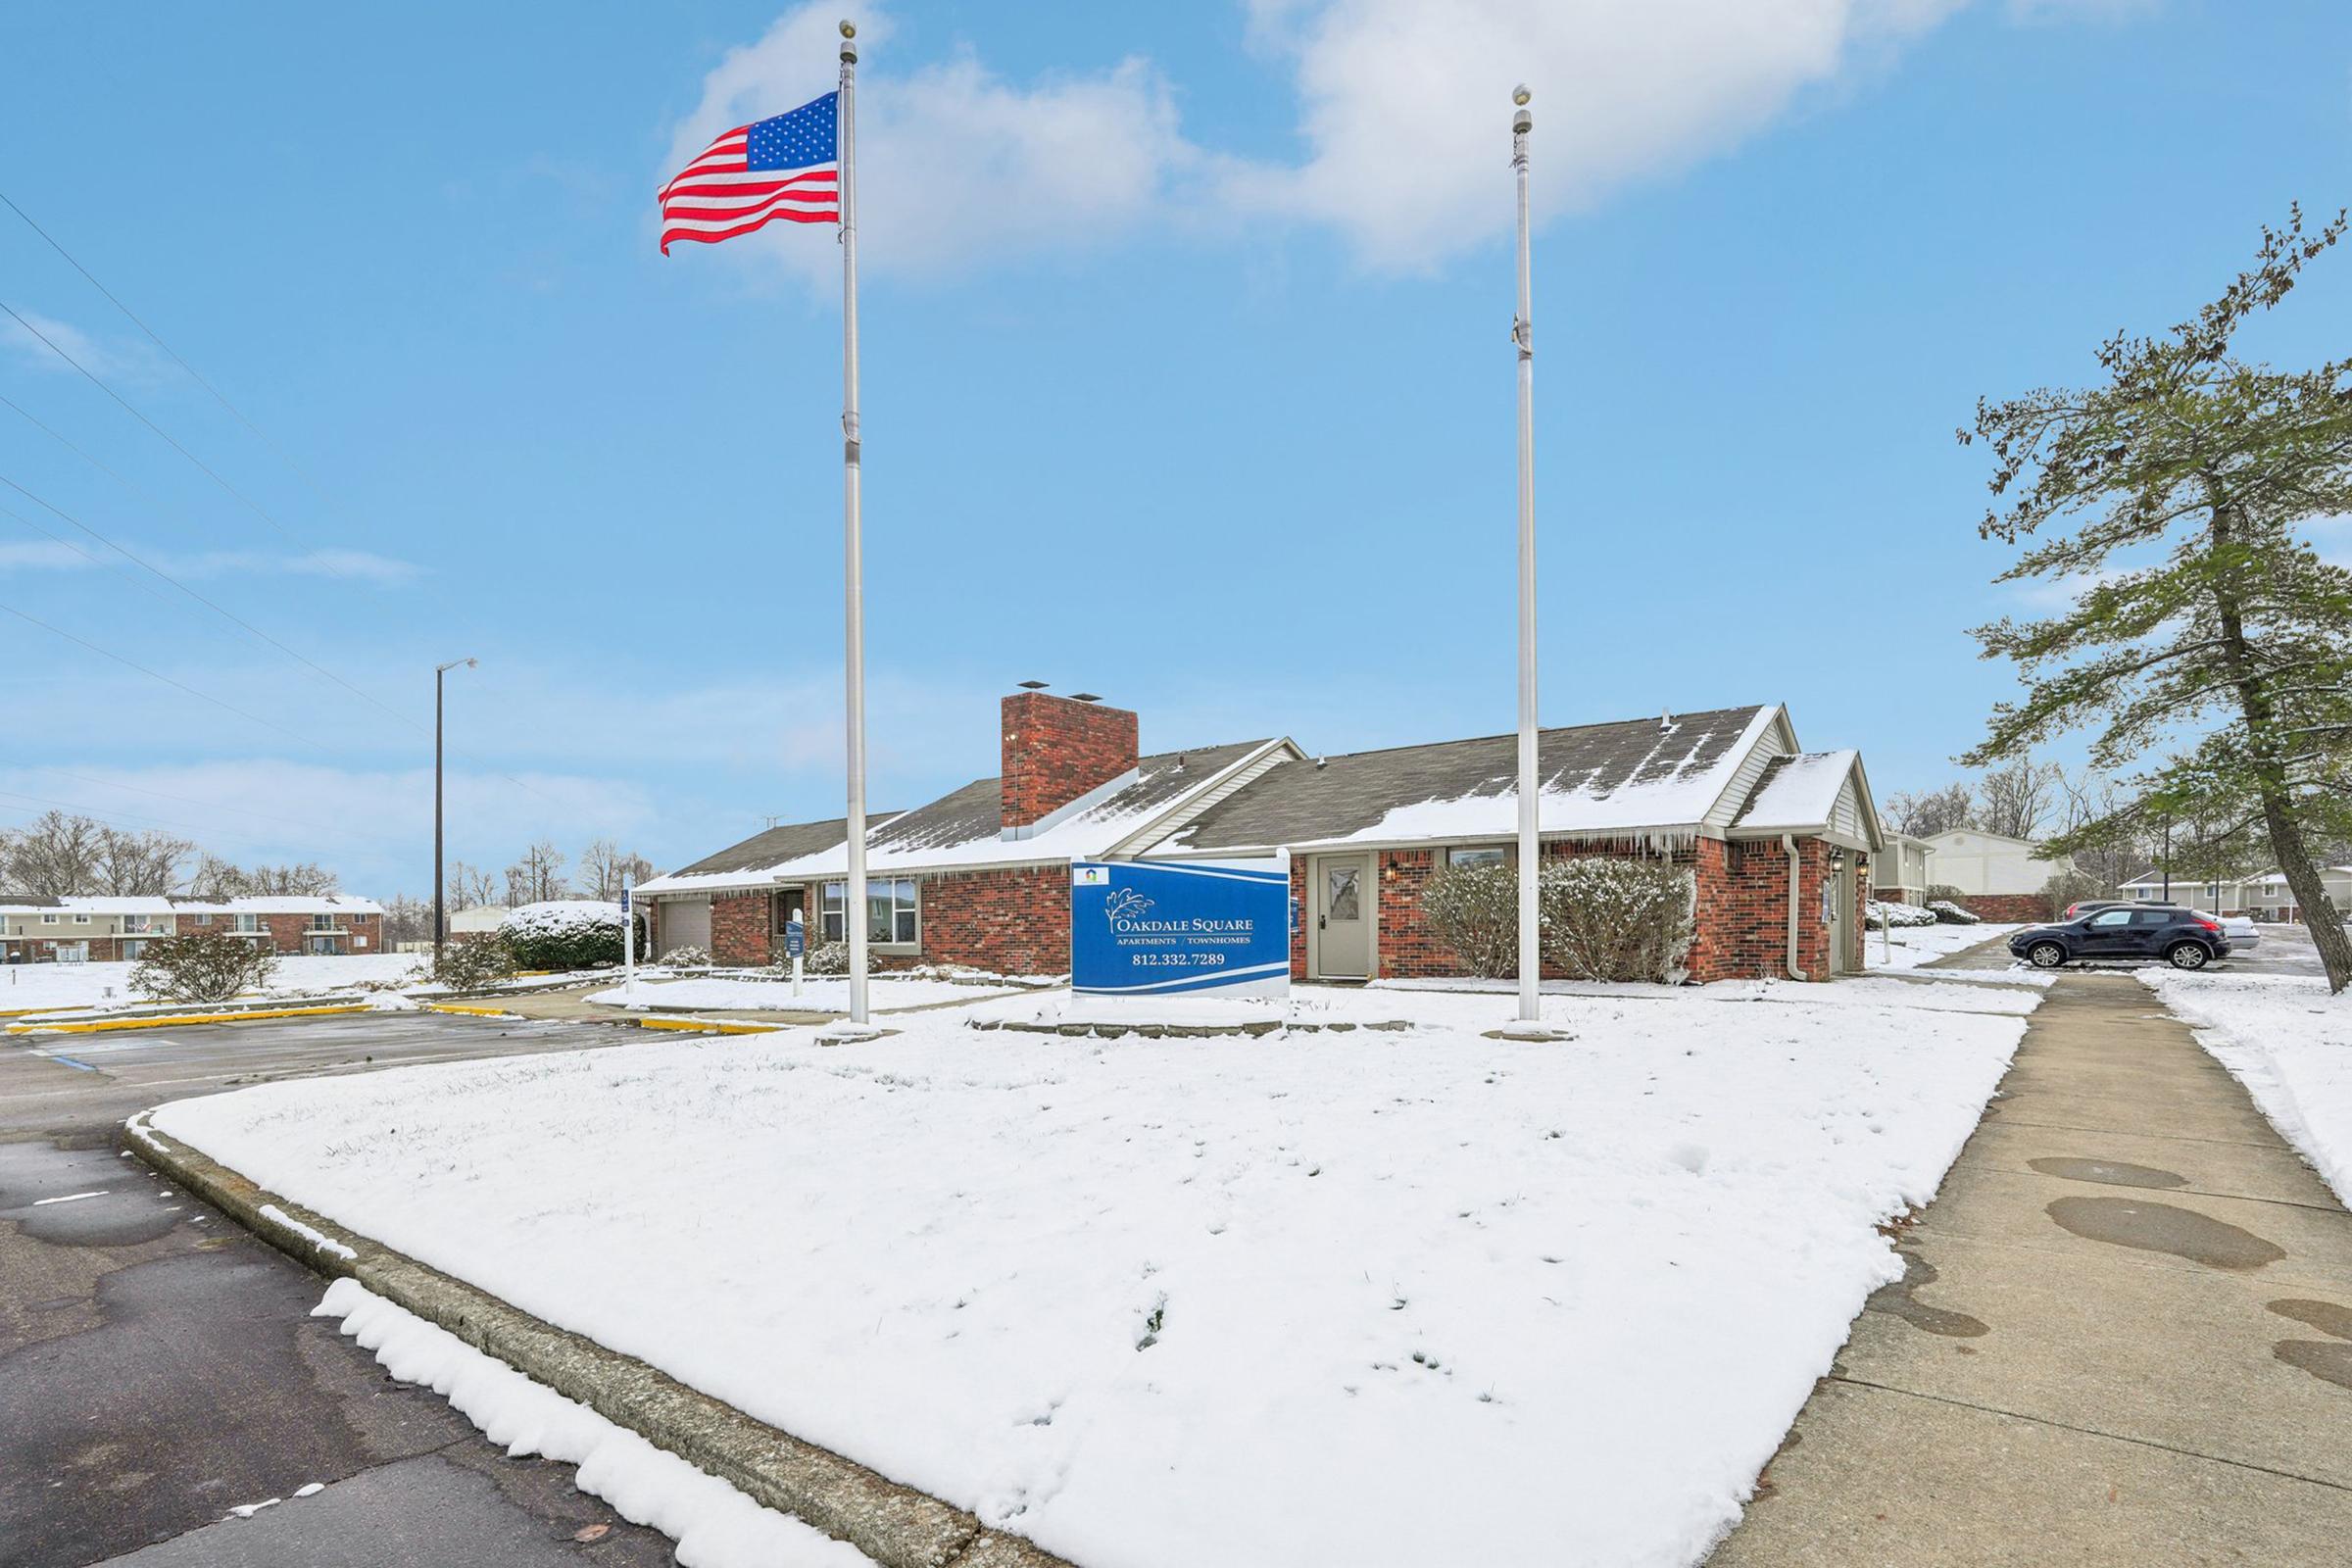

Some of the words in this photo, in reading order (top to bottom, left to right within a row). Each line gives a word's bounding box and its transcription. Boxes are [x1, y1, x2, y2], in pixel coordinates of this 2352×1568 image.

[1116, 919, 1190, 932] OAKDALE
[1192, 917, 1253, 932] SQUARE
[1116, 937, 1177, 946] APARTMENTS
[1187, 936, 1251, 945] TOWNHOMES
[1132, 954, 1225, 965] 812.332.7289
